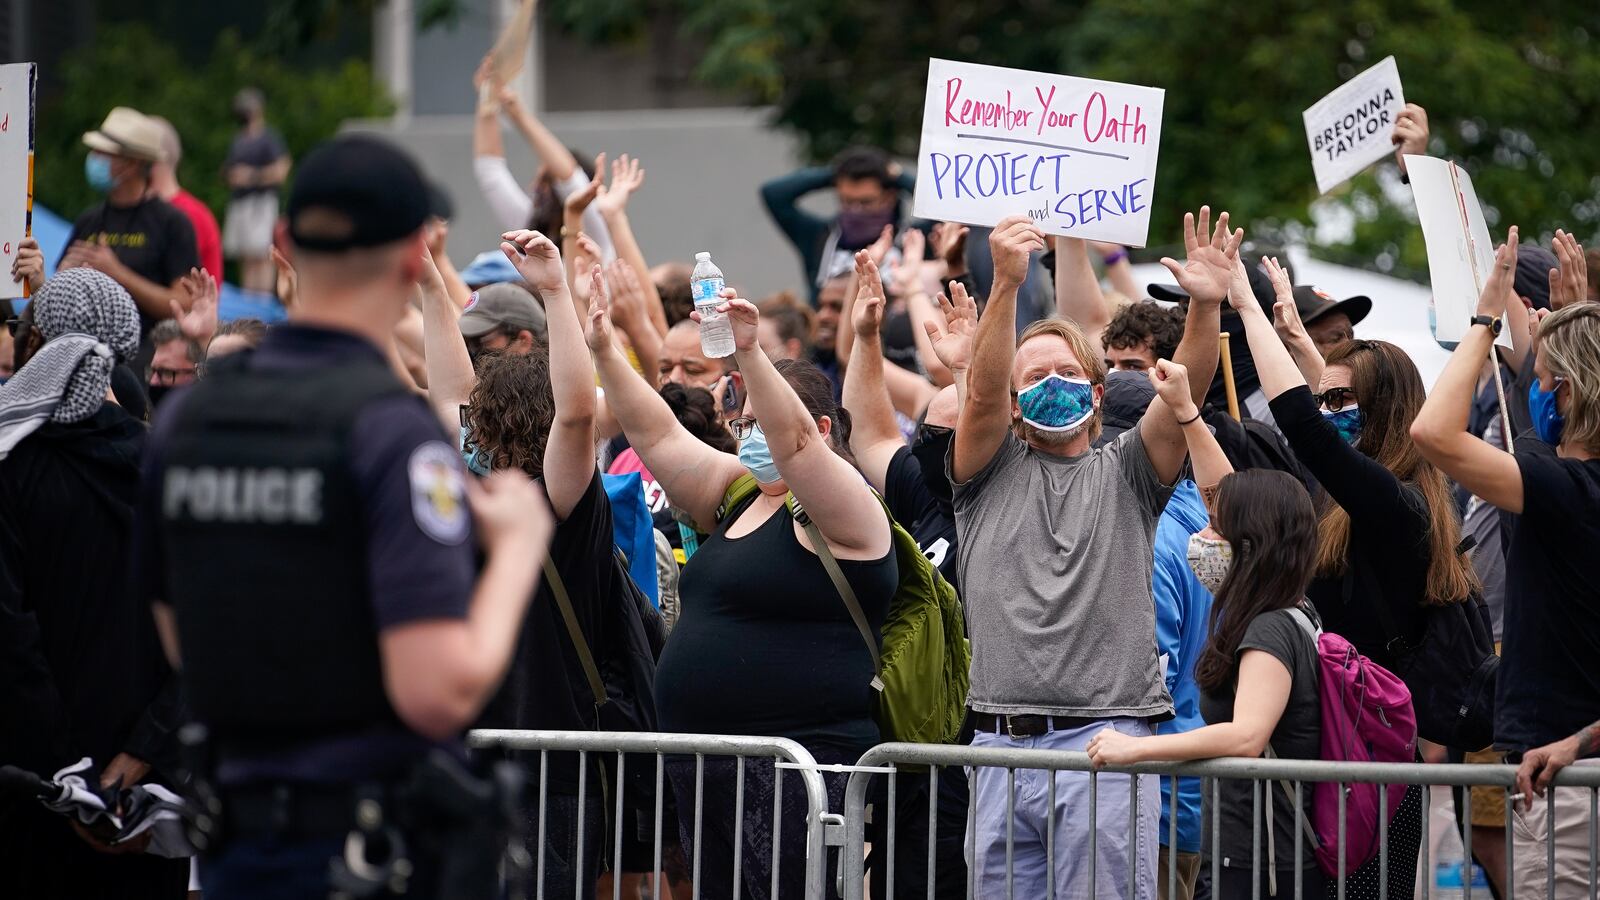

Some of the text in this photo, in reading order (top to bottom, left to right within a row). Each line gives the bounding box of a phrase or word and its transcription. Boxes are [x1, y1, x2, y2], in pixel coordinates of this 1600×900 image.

[945, 77, 1147, 145] Remember Your Oath
[1314, 88, 1395, 151] BREONNA
[1326, 110, 1391, 161] TAYLOR
[931, 152, 1070, 200] PROTECT
[1028, 178, 1148, 229] and SERVE
[164, 466, 323, 523] POLICE
